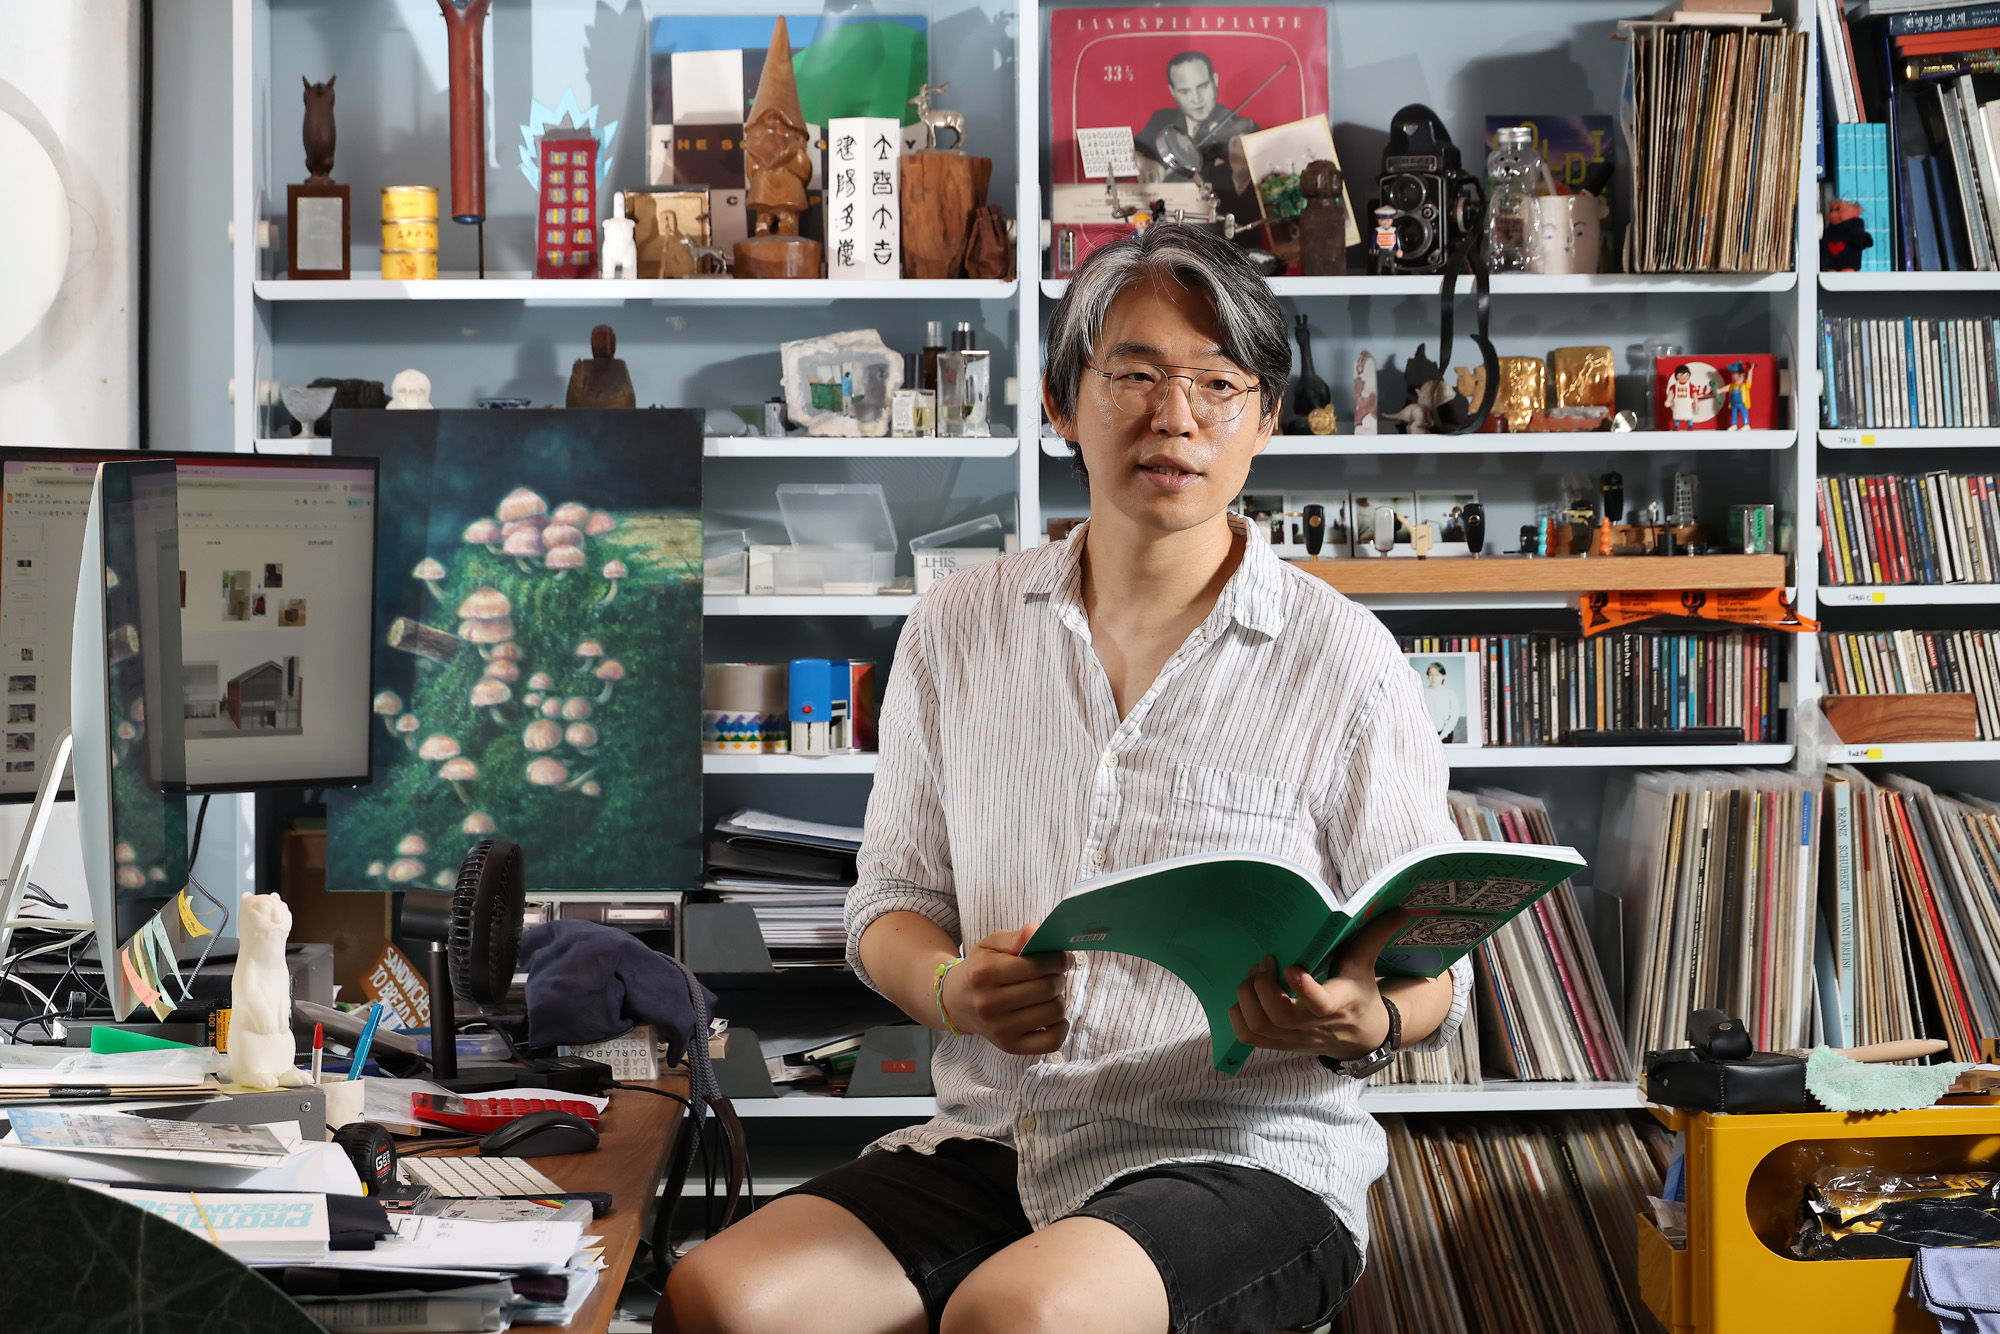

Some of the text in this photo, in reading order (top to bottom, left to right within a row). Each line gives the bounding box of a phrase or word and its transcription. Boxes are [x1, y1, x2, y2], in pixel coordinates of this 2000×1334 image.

[1077, 15, 1302, 31] LANGSPIELPLATTE
[1104, 65, 1122, 82] 33
[661, 139, 707, 150] THE
[1623, 633, 1632, 677] bauhaus
[1837, 807, 1847, 836] FRANZ
[1838, 845, 1849, 891] SCHUBERT
[369, 964, 388, 988] TO
